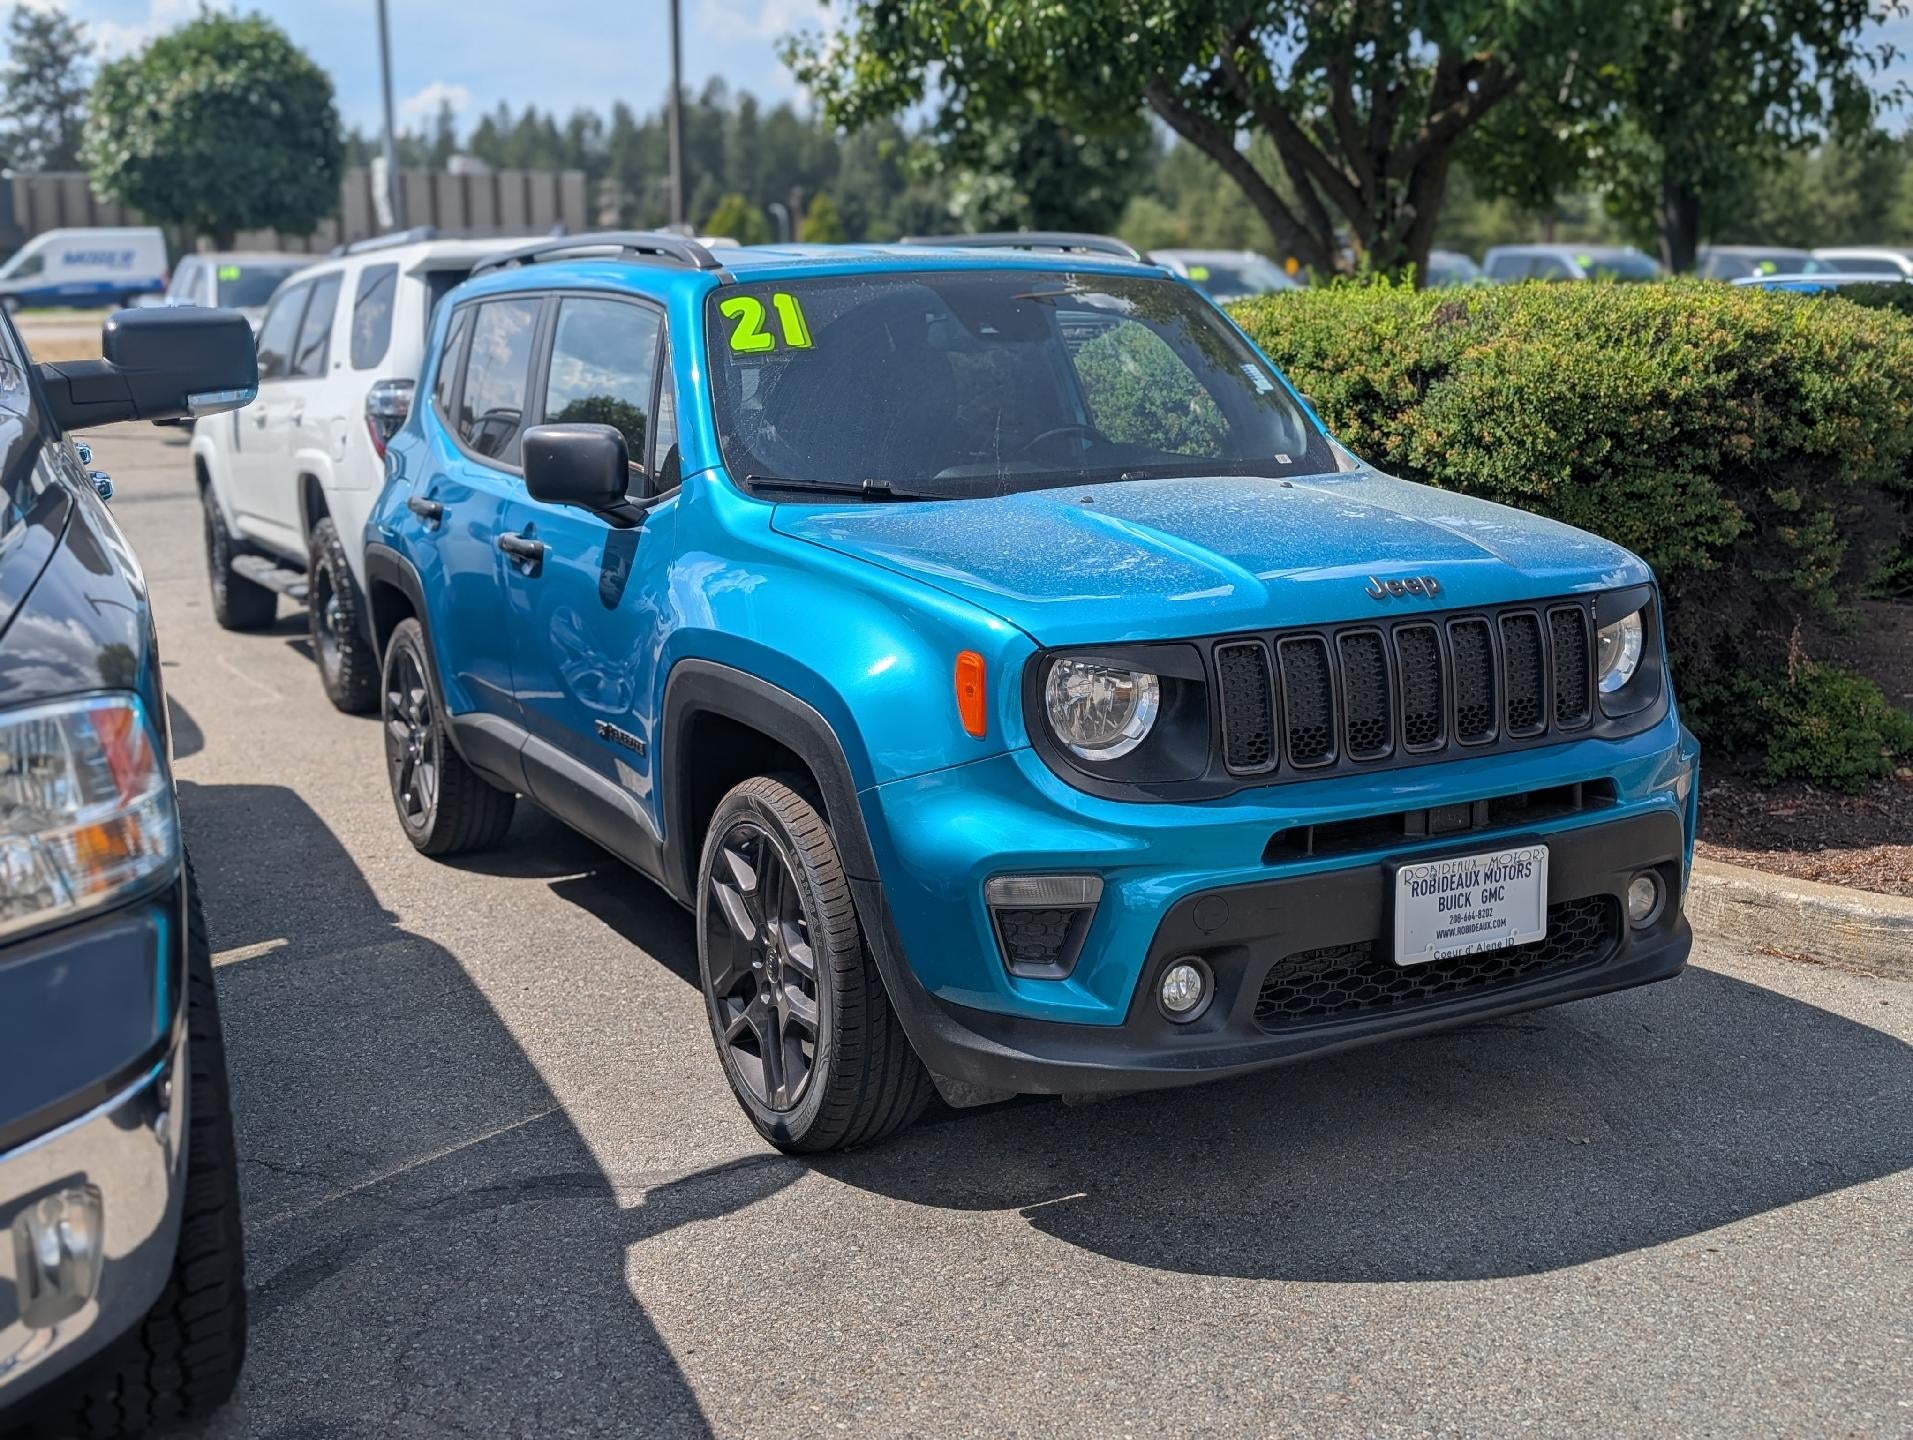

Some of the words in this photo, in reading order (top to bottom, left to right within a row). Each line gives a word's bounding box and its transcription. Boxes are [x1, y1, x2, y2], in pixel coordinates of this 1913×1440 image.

[720, 293, 812, 352] 21
[1365, 575, 1439, 599] Jeep
[1411, 870, 1479, 897] ROBIDEAUX
[1484, 862, 1531, 884] MOTORS
[1439, 892, 1471, 912] BUICK
[1482, 886, 1504, 904] GMC
[1449, 908, 1493, 924] 208-664-8202
[1436, 918, 1506, 939] WWW.ROBIDEAUX.COM
[1434, 949, 1462, 960] Coeur
[1505, 937, 1515, 947] ID
